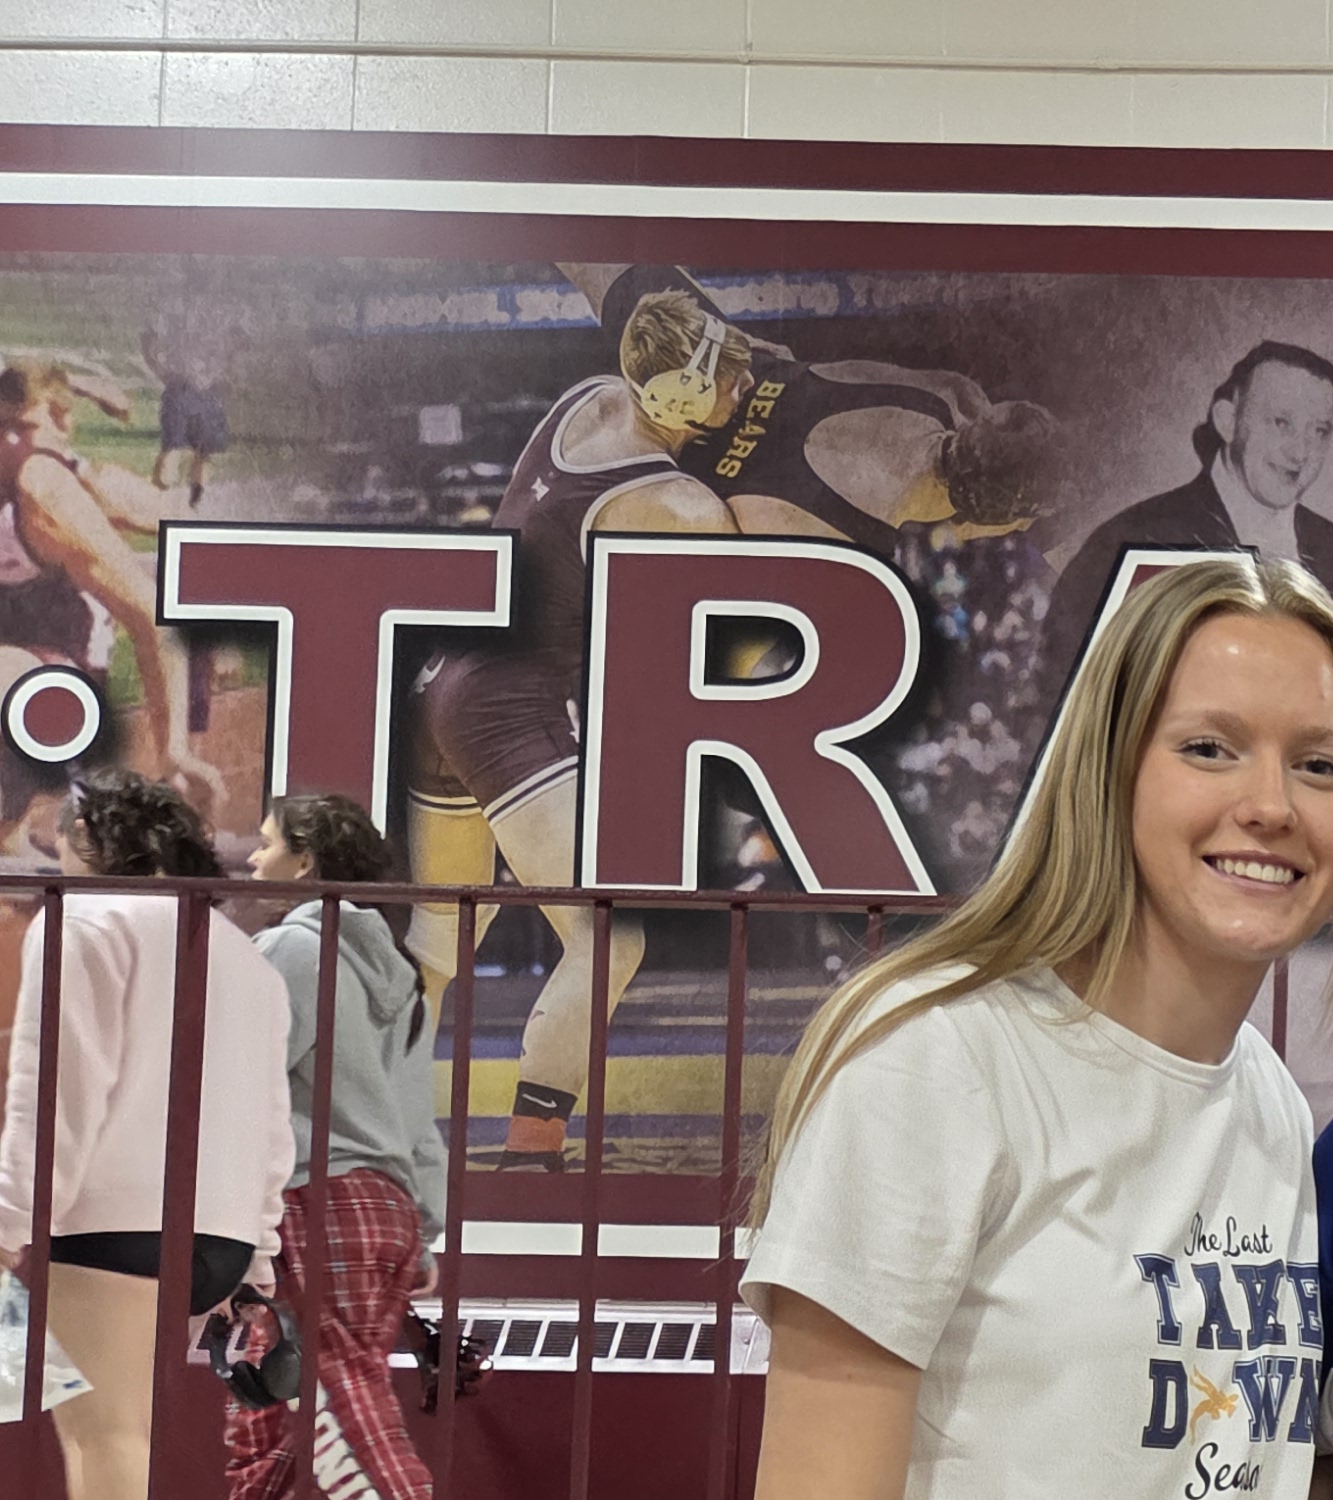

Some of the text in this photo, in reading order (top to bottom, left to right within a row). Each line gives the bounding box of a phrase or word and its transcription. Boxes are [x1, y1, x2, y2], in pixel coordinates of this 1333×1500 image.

[715, 380, 786, 478] BEARS
[1184, 1212, 1273, 1257] The Last
